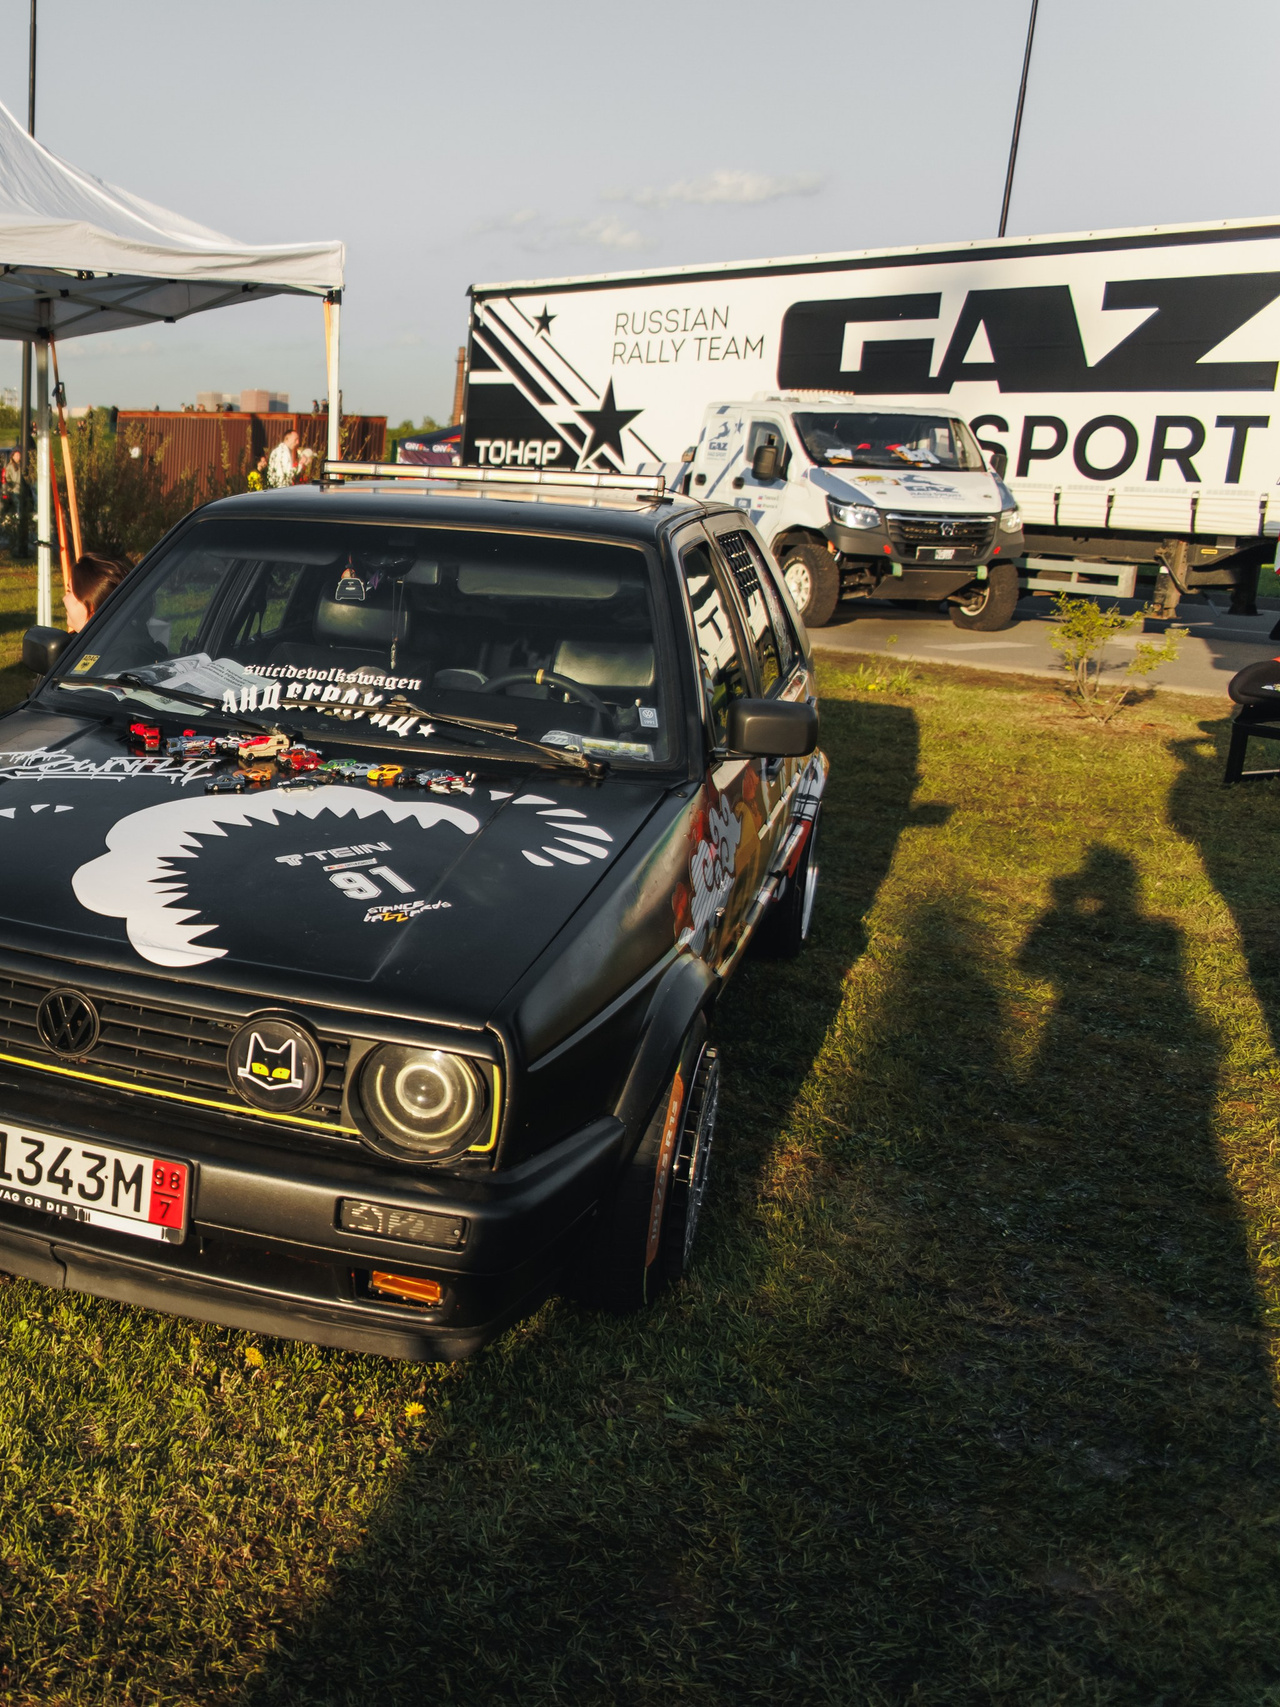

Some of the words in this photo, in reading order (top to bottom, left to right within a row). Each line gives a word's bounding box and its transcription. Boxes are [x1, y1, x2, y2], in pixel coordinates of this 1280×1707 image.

[615, 306, 729, 336] RUSSIAN
[777, 272, 1280, 395] GAZ
[612, 338, 686, 365] RALLY
[694, 335, 765, 362] TEAM
[970, 415, 1270, 485] SPORT
[243, 664, 422, 691] suicidevolkswagen
[329, 866, 416, 900] 91
[154, 1167, 181, 1190] 98
[24, 1196, 41, 1208] OR
[46, 1201, 68, 1215] DIE
[159, 1200, 171, 1220] 7
